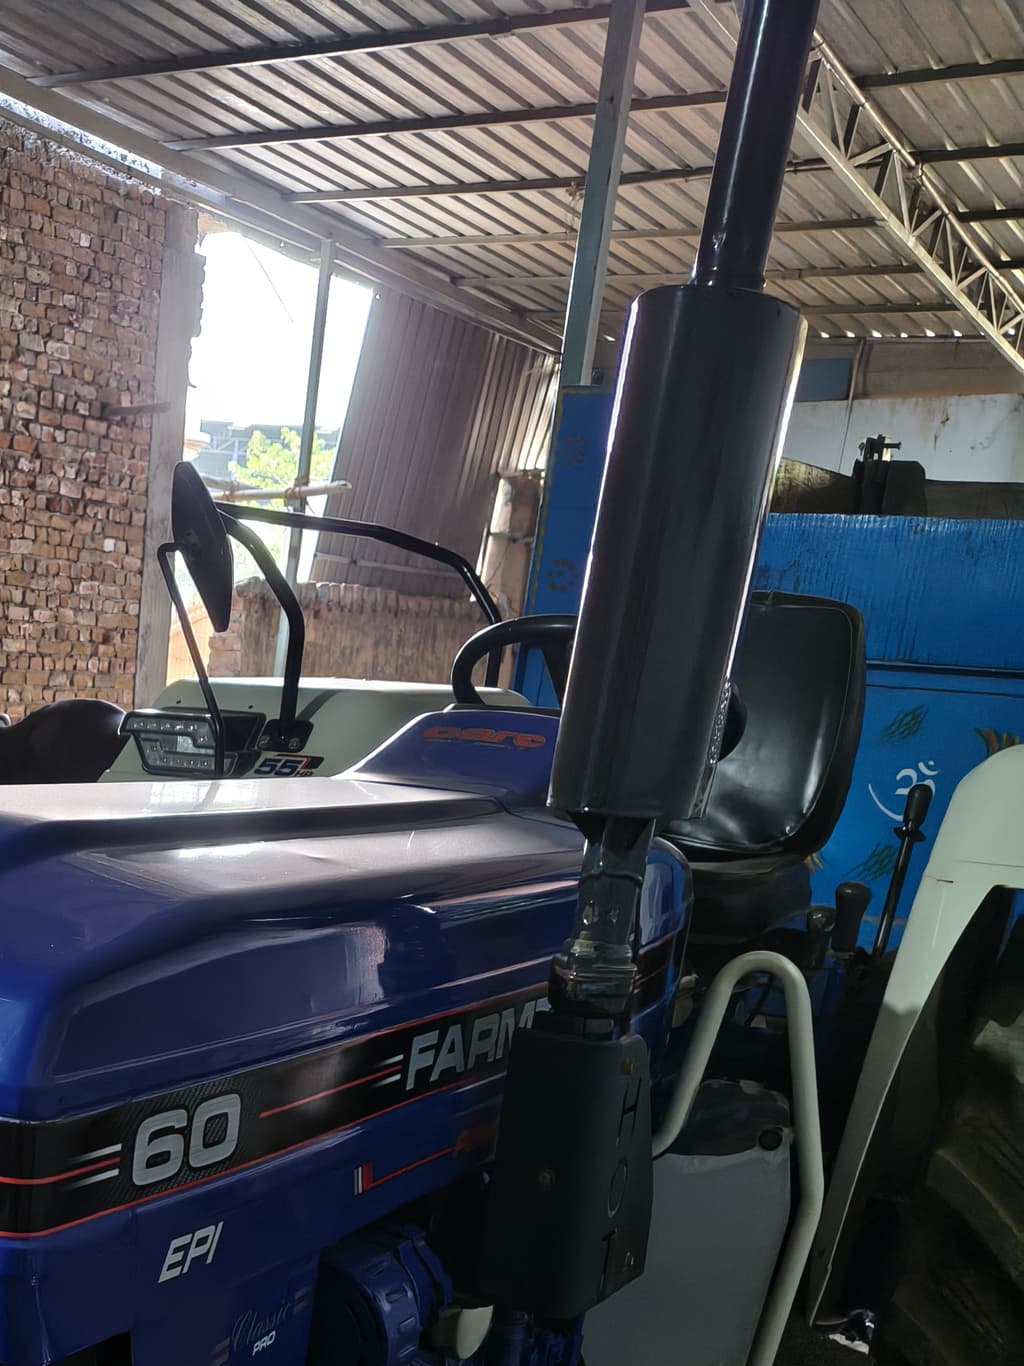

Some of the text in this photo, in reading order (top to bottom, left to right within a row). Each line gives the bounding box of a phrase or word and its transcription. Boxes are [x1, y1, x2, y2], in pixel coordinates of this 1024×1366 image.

[255, 758, 305, 776] 55
[131, 1092, 243, 1187] 60
[158, 1220, 225, 1284] EPI
[252, 1329, 277, 1357] PRO
